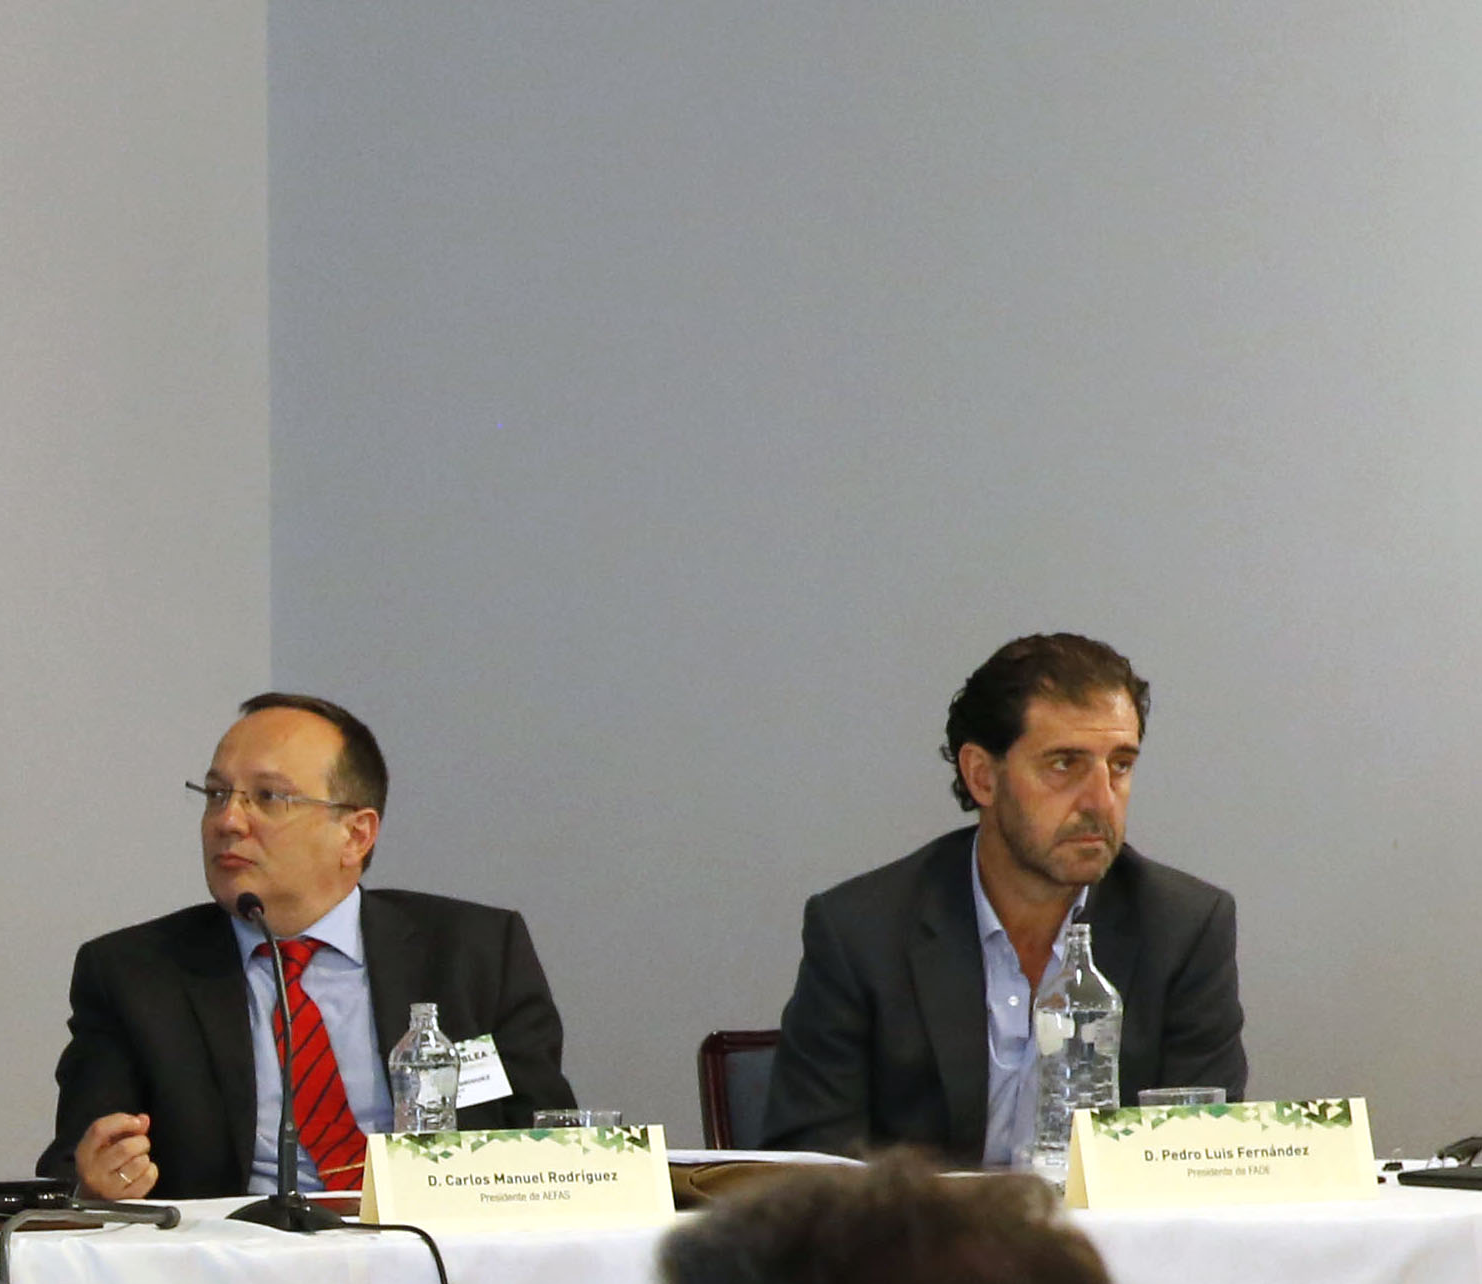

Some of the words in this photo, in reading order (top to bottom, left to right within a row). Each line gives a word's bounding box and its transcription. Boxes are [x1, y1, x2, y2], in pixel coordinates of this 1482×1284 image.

[1145, 1149, 1158, 1162] D.
[1162, 1149, 1202, 1161] Pedro
[1205, 1147, 1234, 1160] Luis
[1237, 1144, 1310, 1159] Fernández
[427, 1174, 442, 1187] D.
[445, 1173, 490, 1186] Carlos
[494, 1172, 544, 1185] Manuel
[480, 1192, 527, 1203] Presidente
[529, 1191, 540, 1202] de
